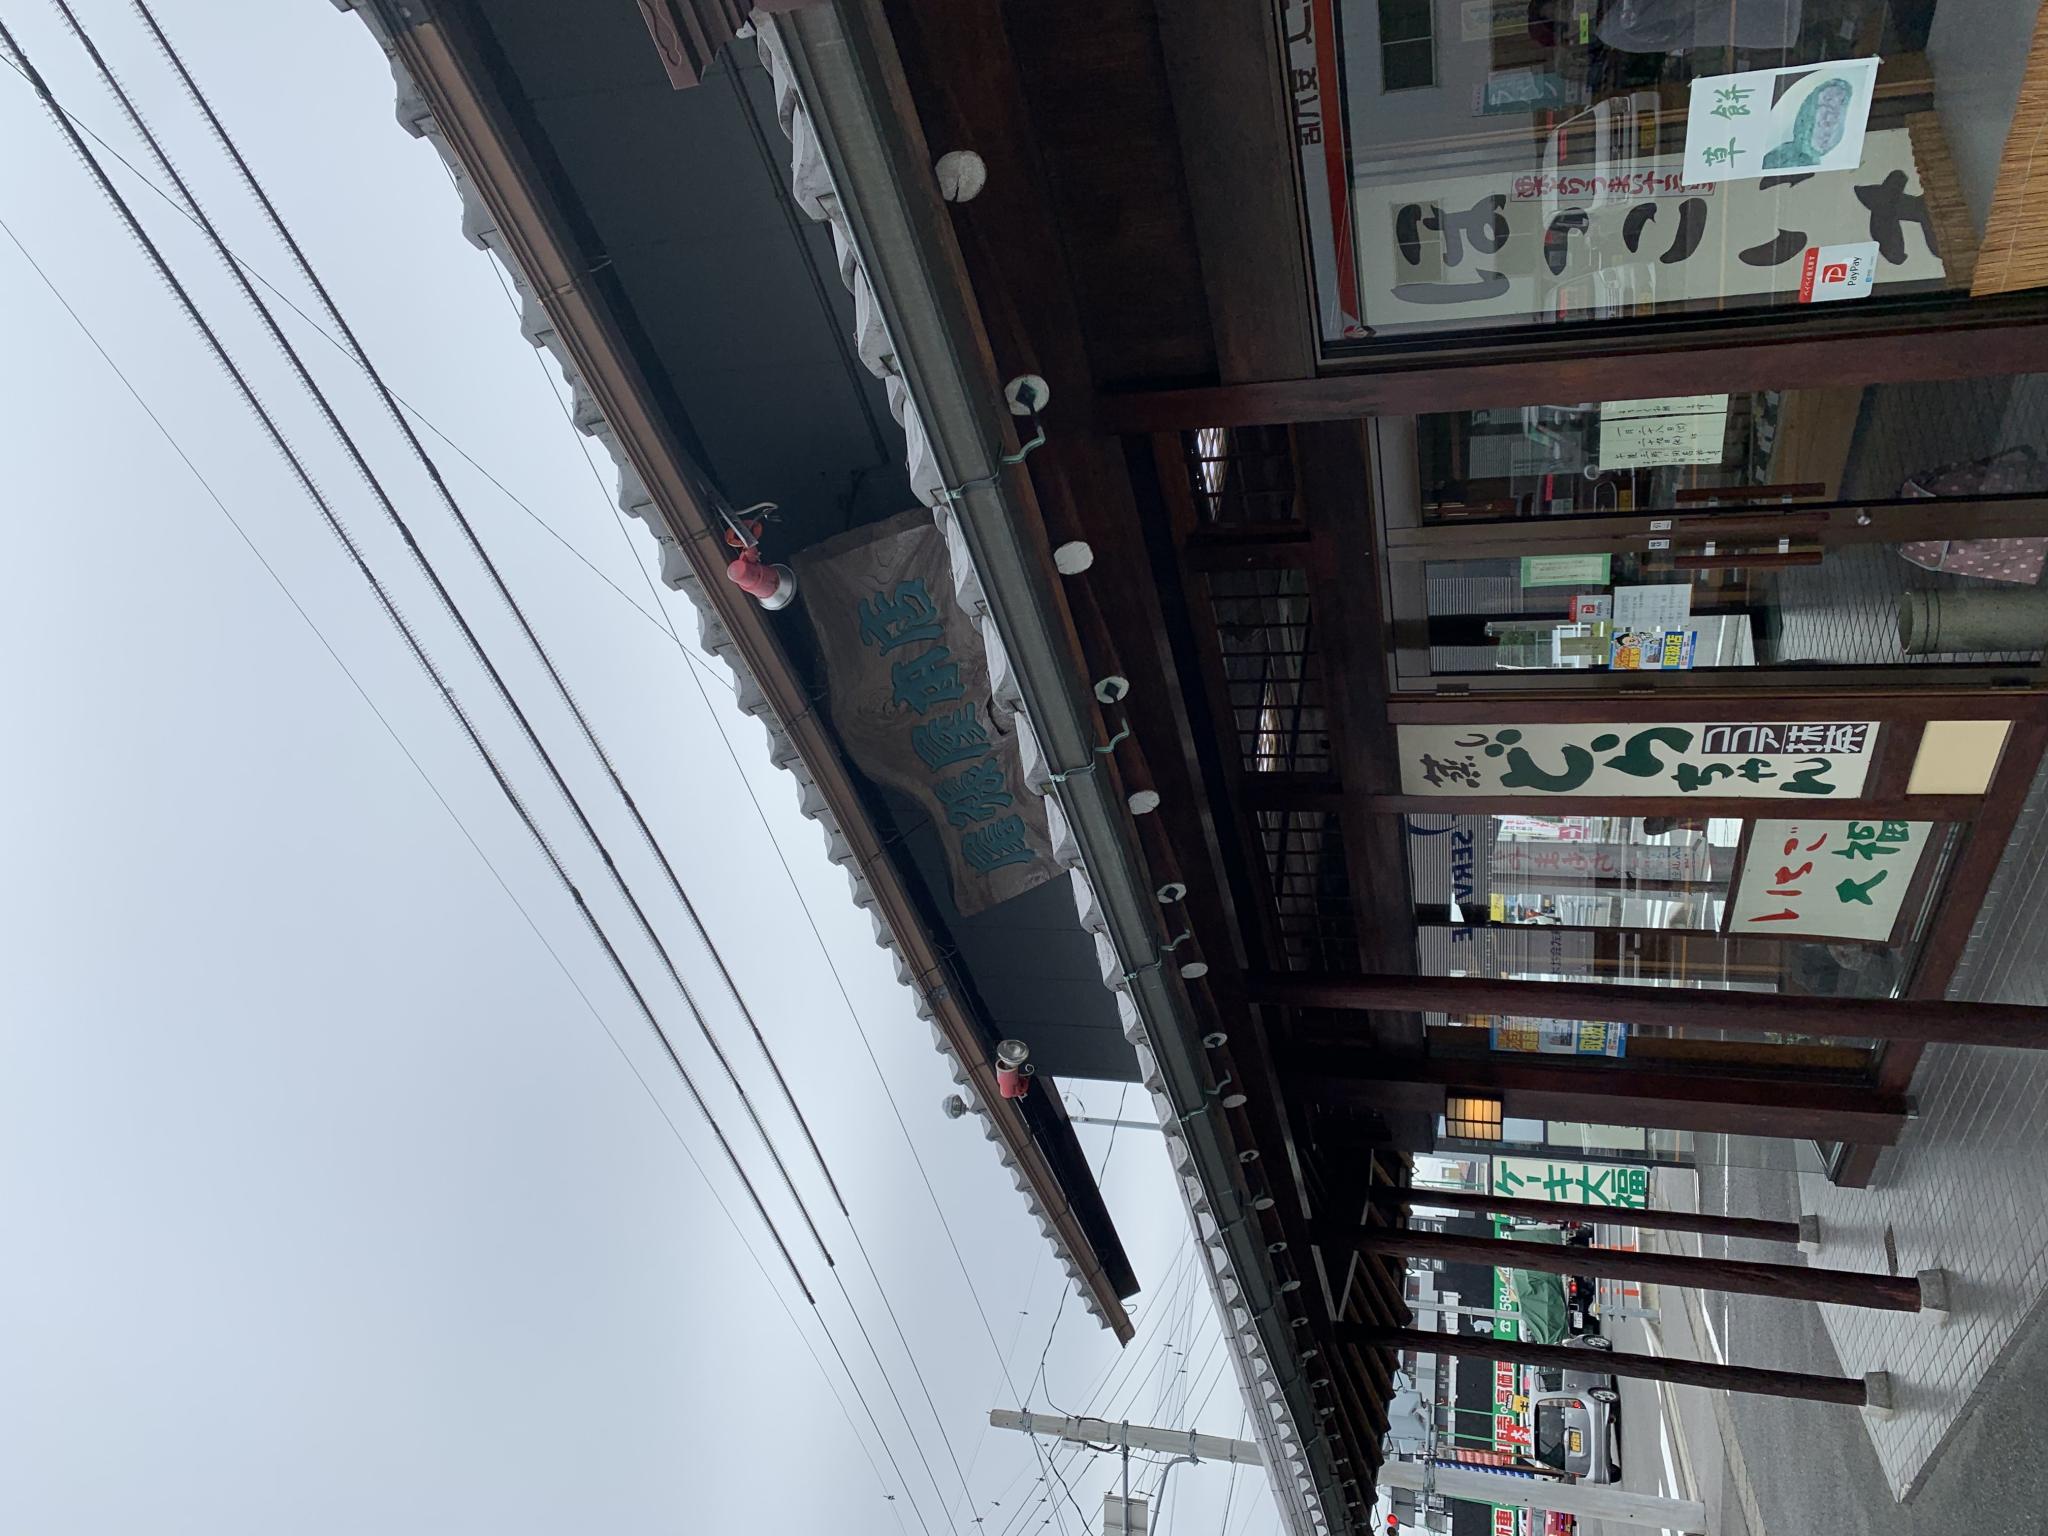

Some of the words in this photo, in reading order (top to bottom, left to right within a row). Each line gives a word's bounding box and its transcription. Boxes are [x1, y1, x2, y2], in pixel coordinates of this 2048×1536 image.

[1702, 83, 1755, 169] 草餅
[1847, 255, 1862, 286] PayPay
[1664, 634, 1683, 666] 取扱店
[1484, 727, 1836, 794] どらちゃん
[1703, 725, 1780, 753] ココア
[1785, 725, 1868, 754] 抹茶
[1747, 826, 1828, 923] いちご
[1831, 820, 1910, 905] 大福
[1494, 1160, 1646, 1208] ケーキ大福
